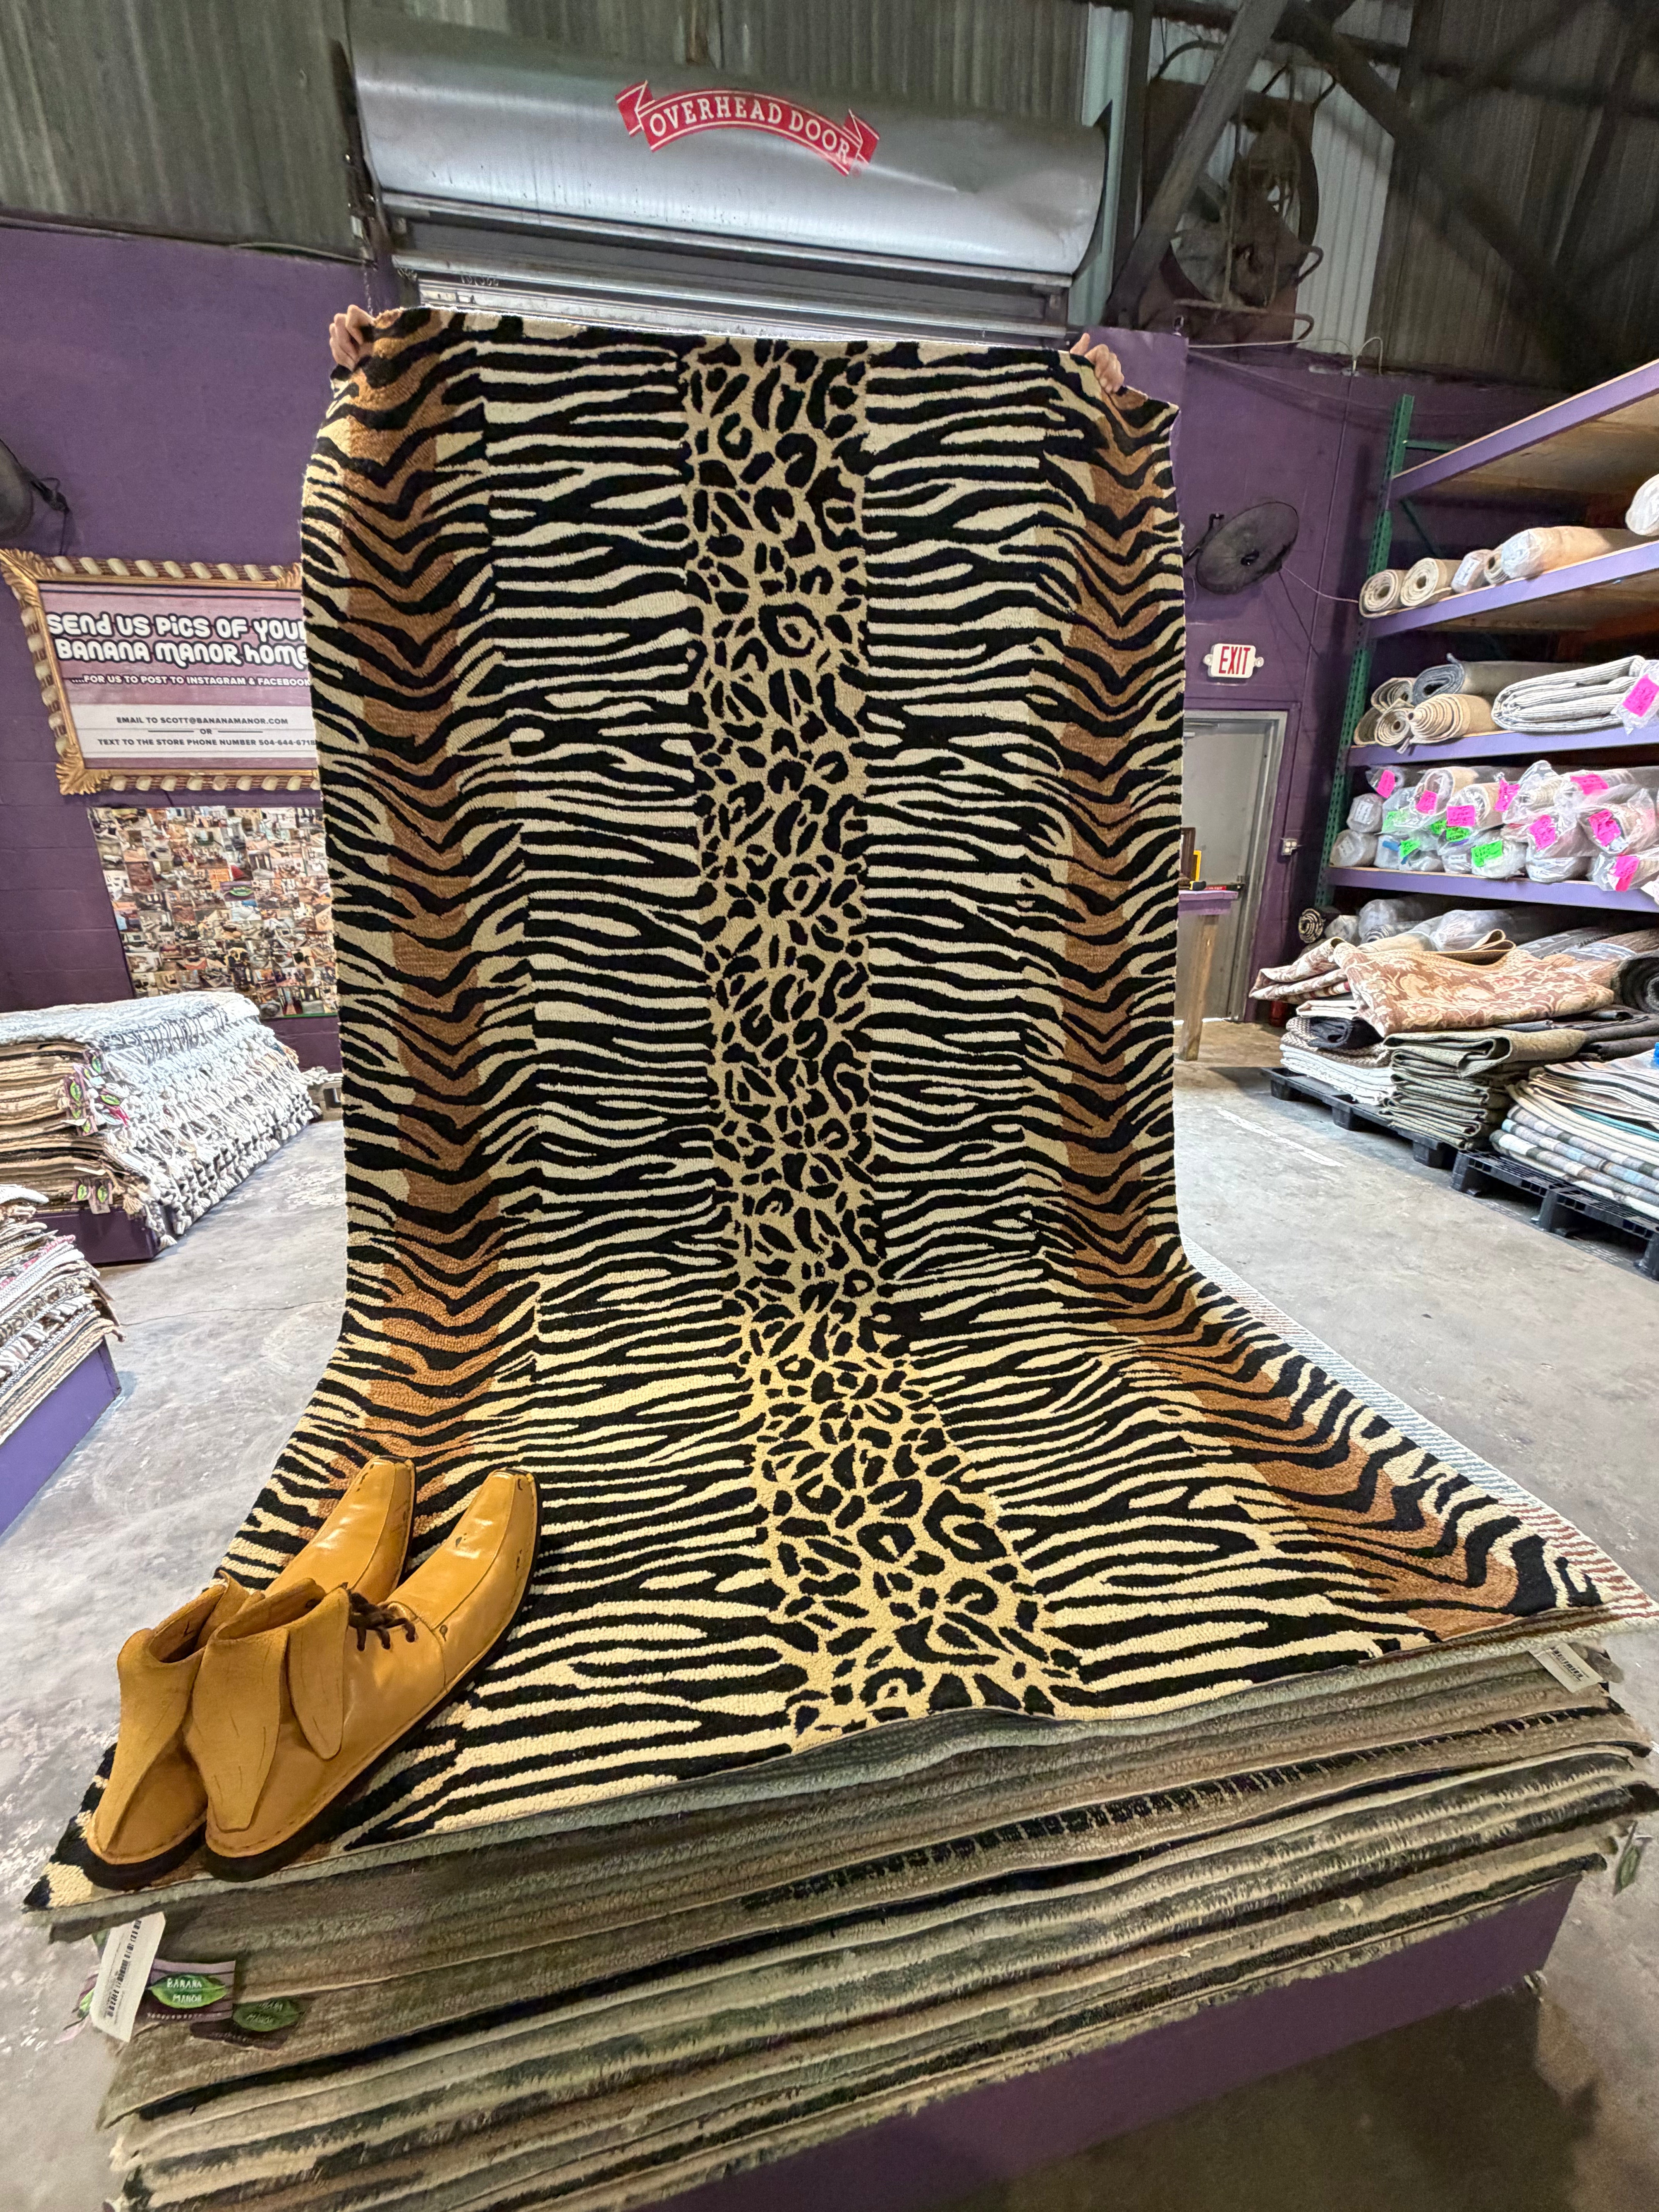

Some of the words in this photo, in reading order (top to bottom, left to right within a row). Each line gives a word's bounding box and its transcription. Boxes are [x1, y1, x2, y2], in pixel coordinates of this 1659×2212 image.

[649, 96, 783, 137] OVERHEAD
[788, 110, 850, 164] DOOR
[116, 615, 151, 636] US
[216, 618, 248, 638] OF
[55, 639, 151, 661] BANANA
[155, 642, 242, 667] MANOR
[1218, 646, 1251, 675] EXIT
[106, 675, 122, 684] US
[123, 675, 139, 684] TO
[140, 676, 168, 684] POST
[169, 676, 185, 684] TO
[186, 677, 246, 685] INSTAGRAM
[248, 677, 256, 685] &
